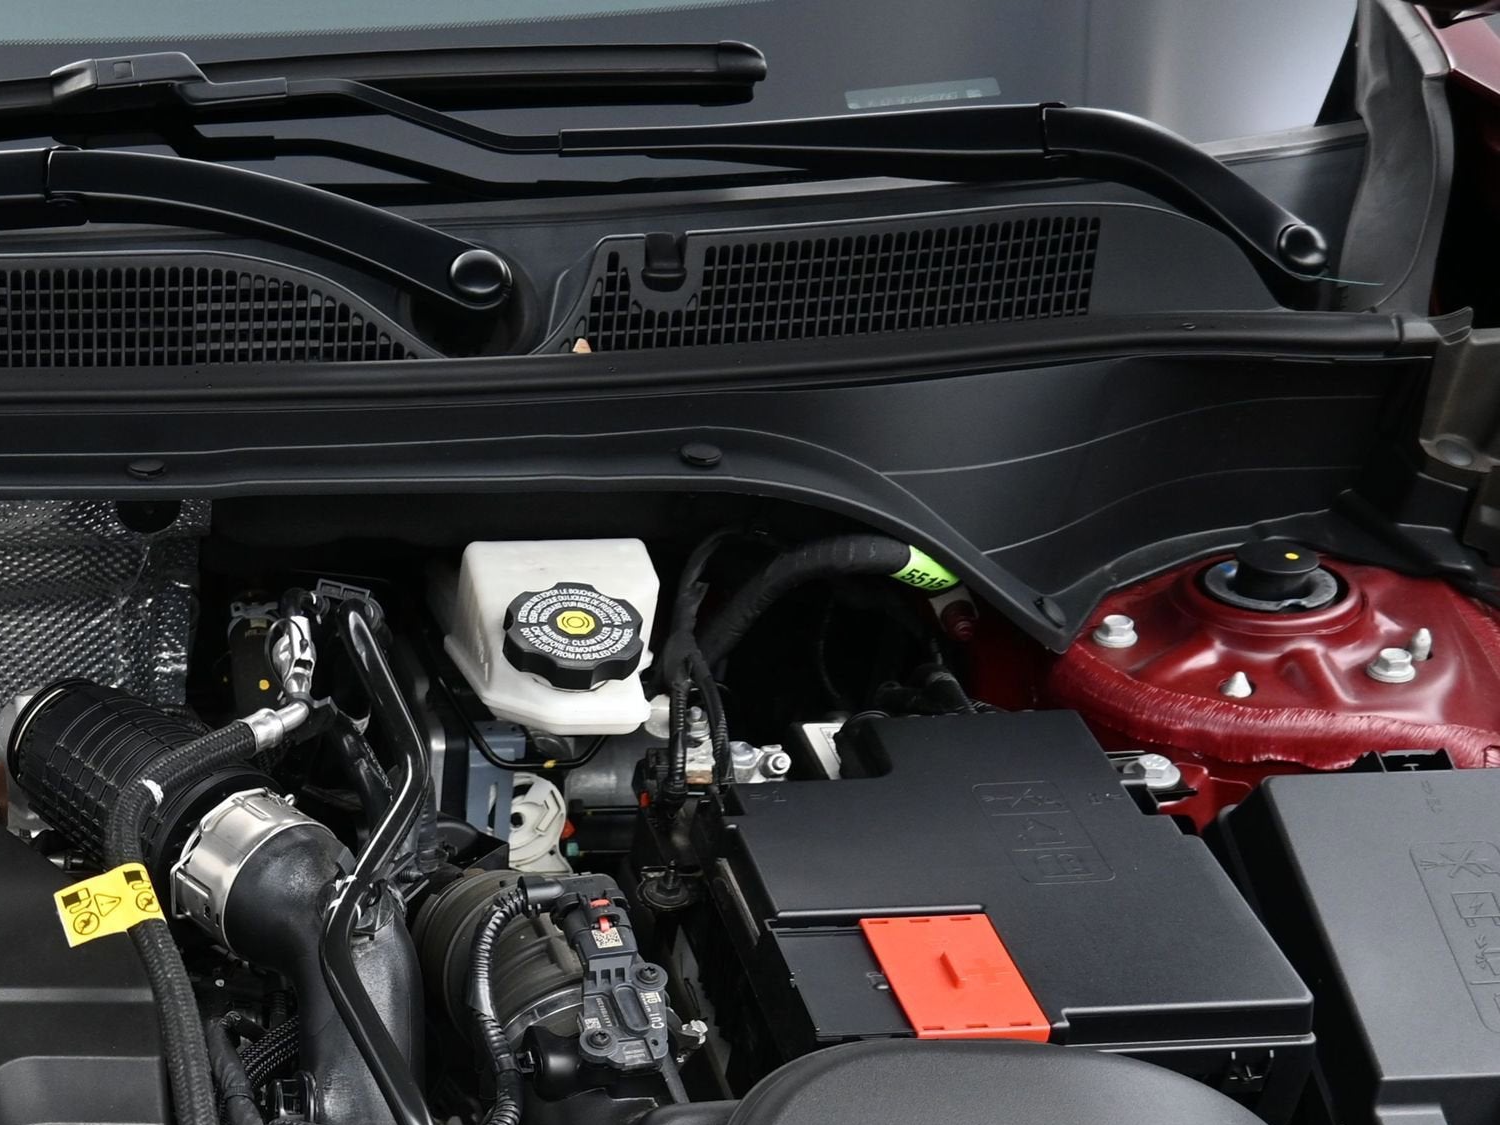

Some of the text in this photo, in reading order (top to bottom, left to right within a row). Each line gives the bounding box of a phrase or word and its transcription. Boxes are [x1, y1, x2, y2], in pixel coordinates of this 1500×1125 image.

[900, 568, 949, 588] 5515
[530, 626, 543, 636] CAP
[537, 635, 565, 650] BEFORE
[529, 639, 553, 653] FLUID
[550, 649, 574, 659] FROM
[582, 648, 612, 659] SEALED
